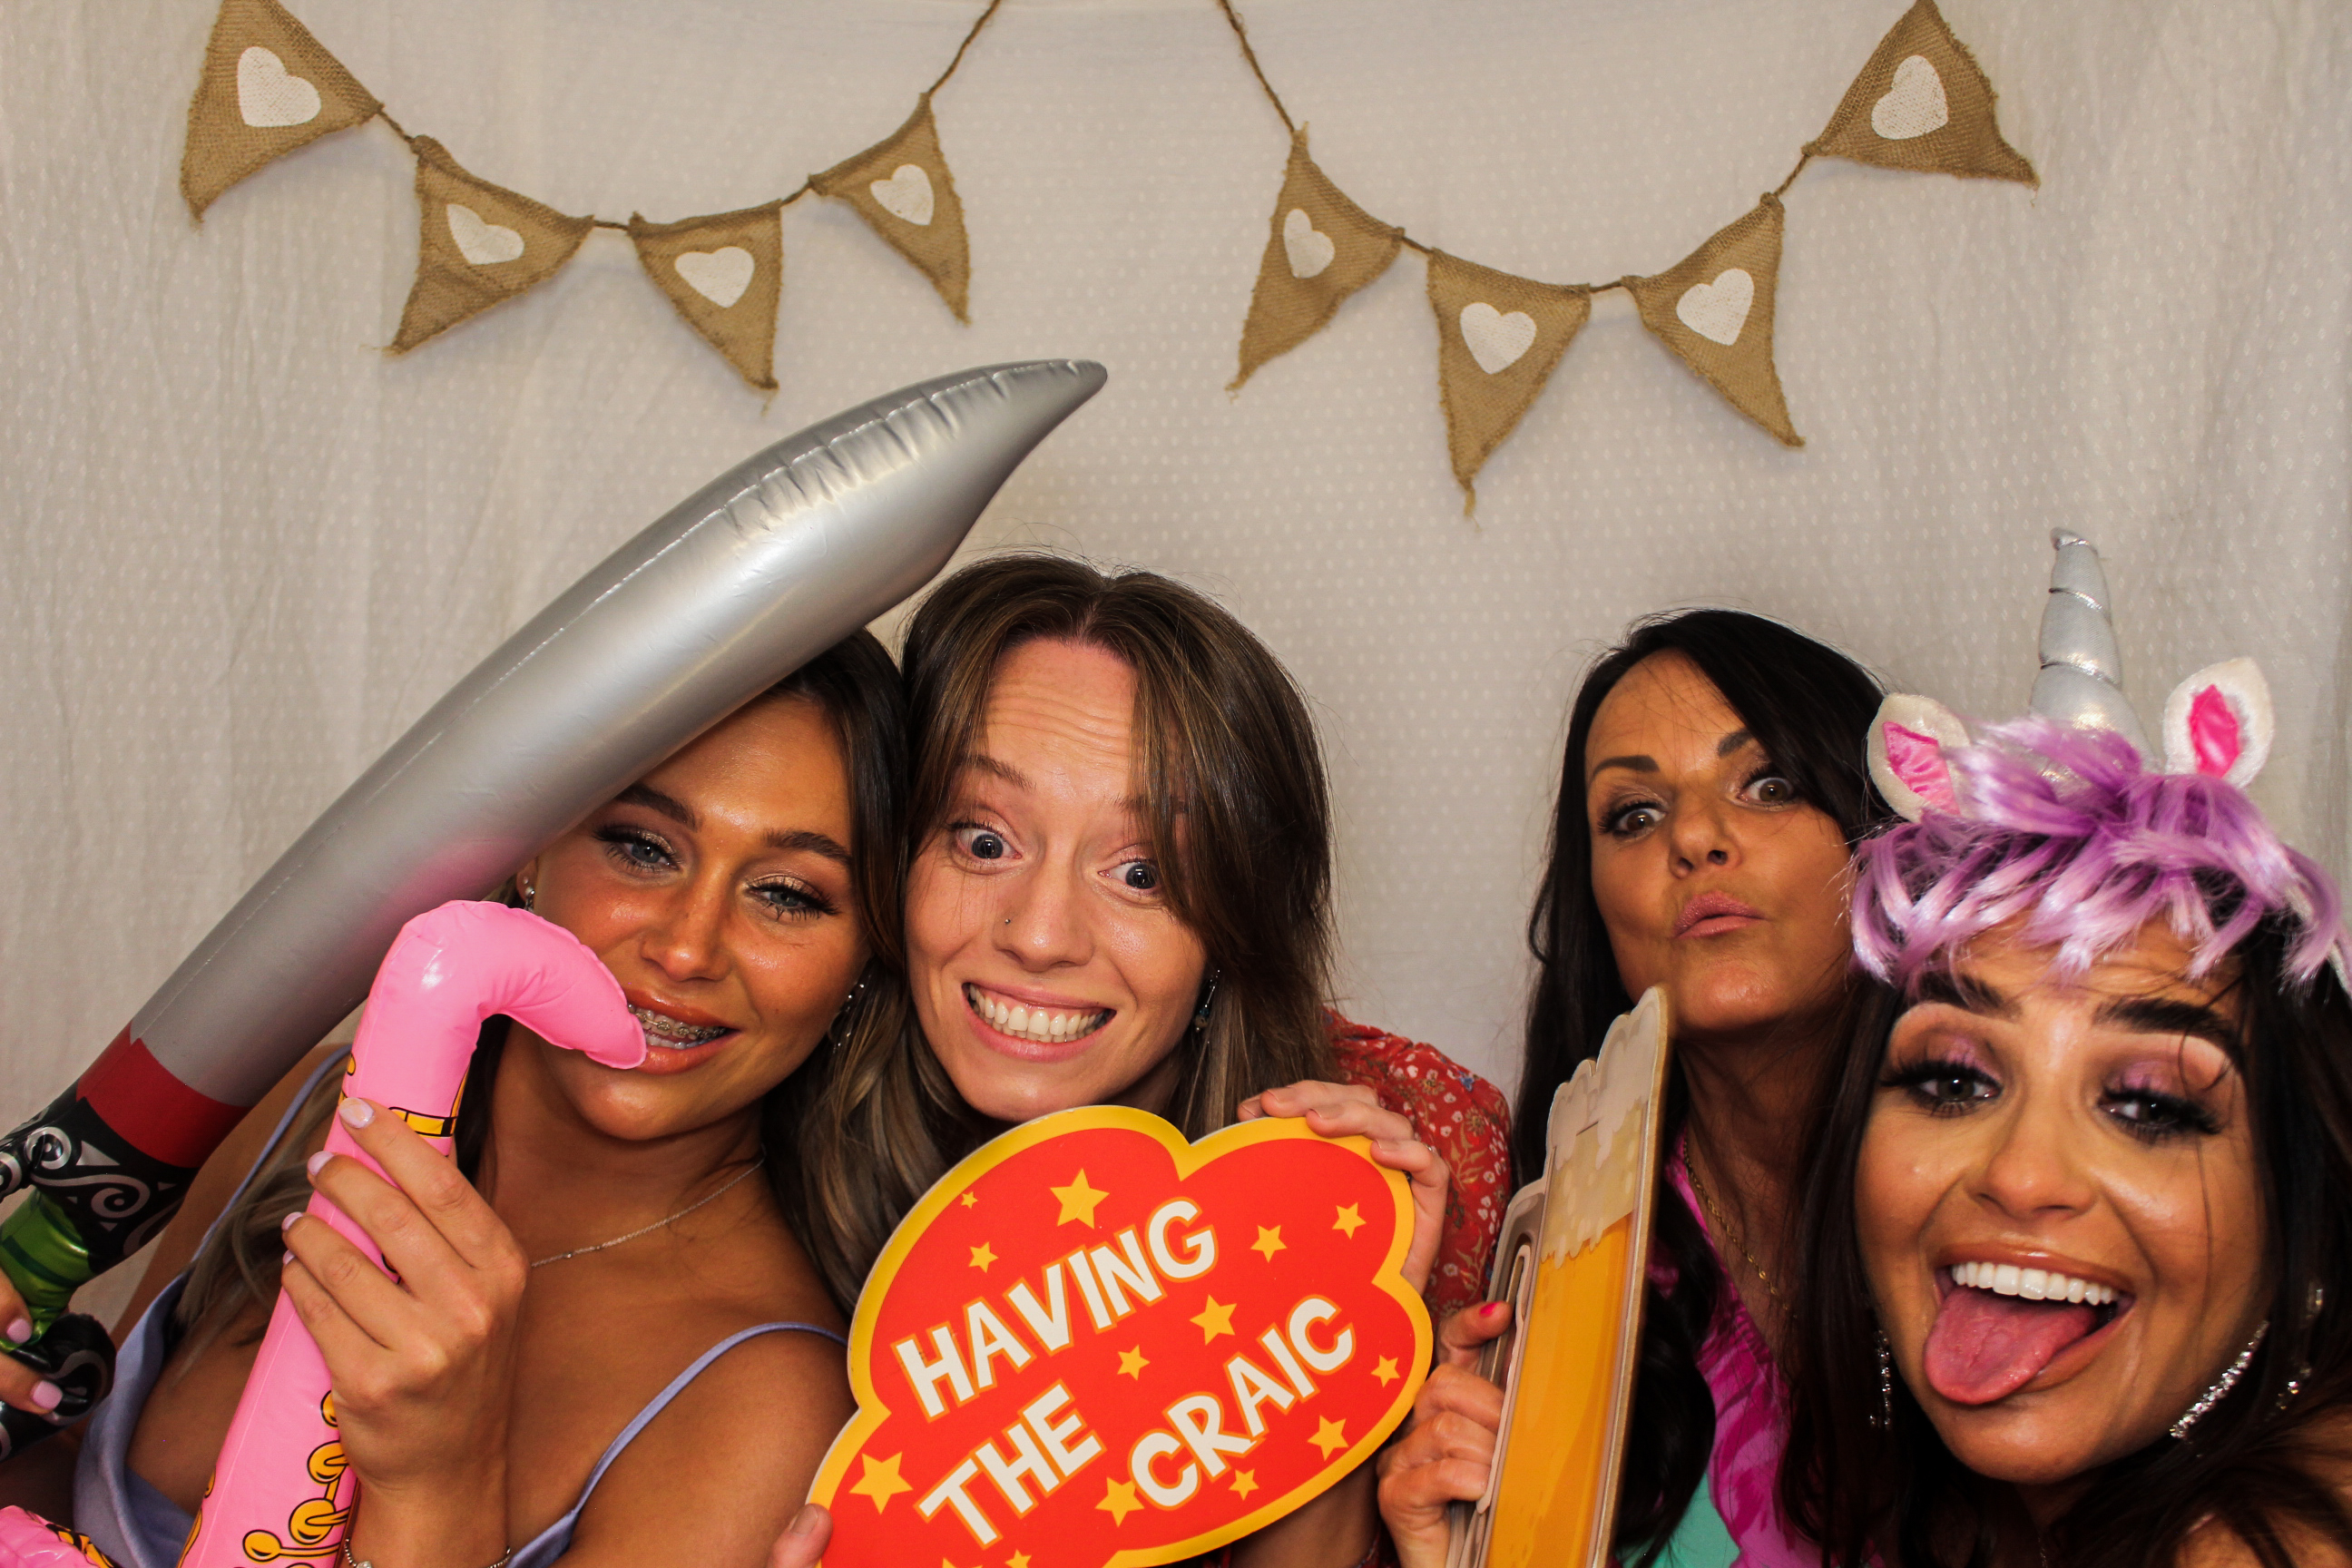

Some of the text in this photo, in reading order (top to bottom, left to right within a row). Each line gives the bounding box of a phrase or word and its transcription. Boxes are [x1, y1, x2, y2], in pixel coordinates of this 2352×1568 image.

[894, 1200, 1218, 1418] HAVING
[917, 1297, 1354, 1545] THE CRAIC
